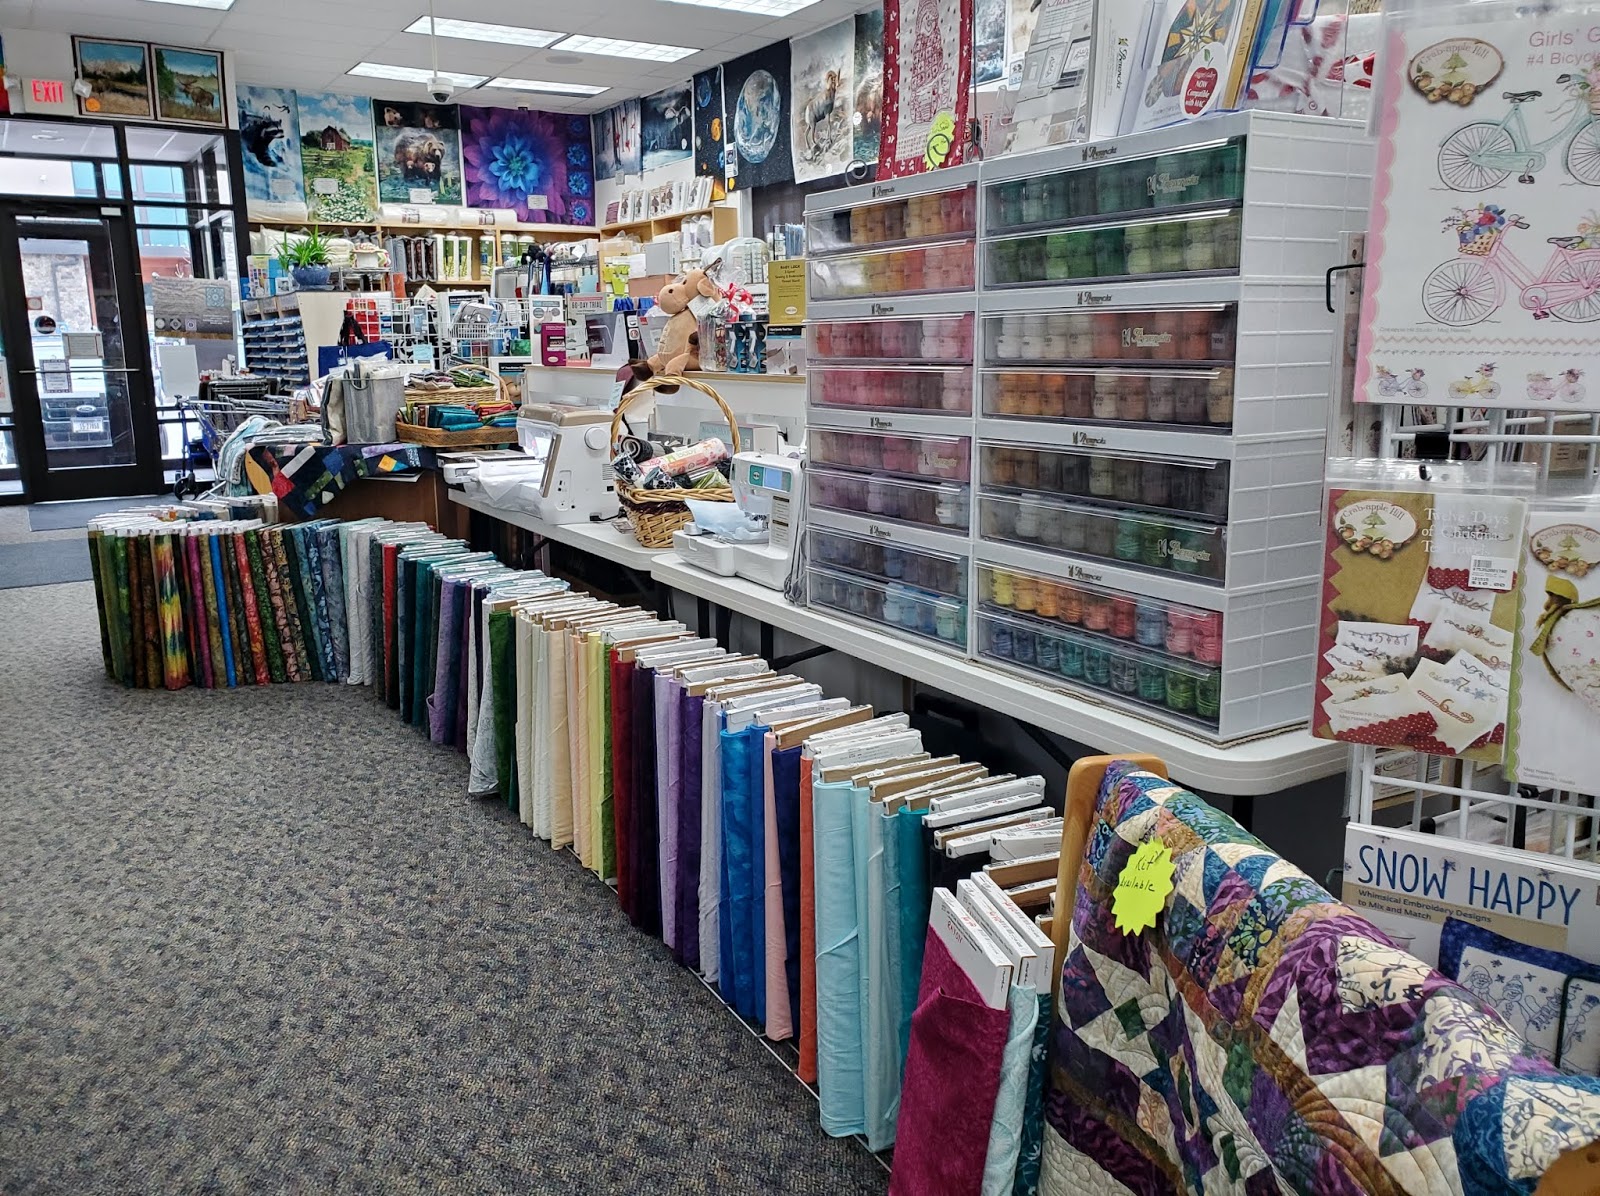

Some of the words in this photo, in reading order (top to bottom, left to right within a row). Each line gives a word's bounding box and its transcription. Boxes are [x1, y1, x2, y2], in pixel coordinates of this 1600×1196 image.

[1529, 28, 1580, 47] Girls'
[1472, 45, 1490, 60] Hill
[1526, 54, 1544, 67] #4
[32, 79, 64, 103] EXIT
[1342, 503, 1388, 518] Crab-apple
[1389, 507, 1406, 520] Hill
[1471, 509, 1510, 527] Days
[1421, 525, 1434, 537] of
[1135, 857, 1155, 872] Kit
[1357, 844, 1449, 900] SNOW
[1468, 866, 1582, 926] HAPPY
[1357, 900, 1367, 908] to
[1368, 901, 1384, 912] Mix
[1385, 904, 1402, 915] and
[1403, 907, 1432, 921] Match
[1358, 888, 1402, 905] Whimsical
[1402, 898, 1454, 917] Embroidery
[1455, 908, 1493, 924] Designs
